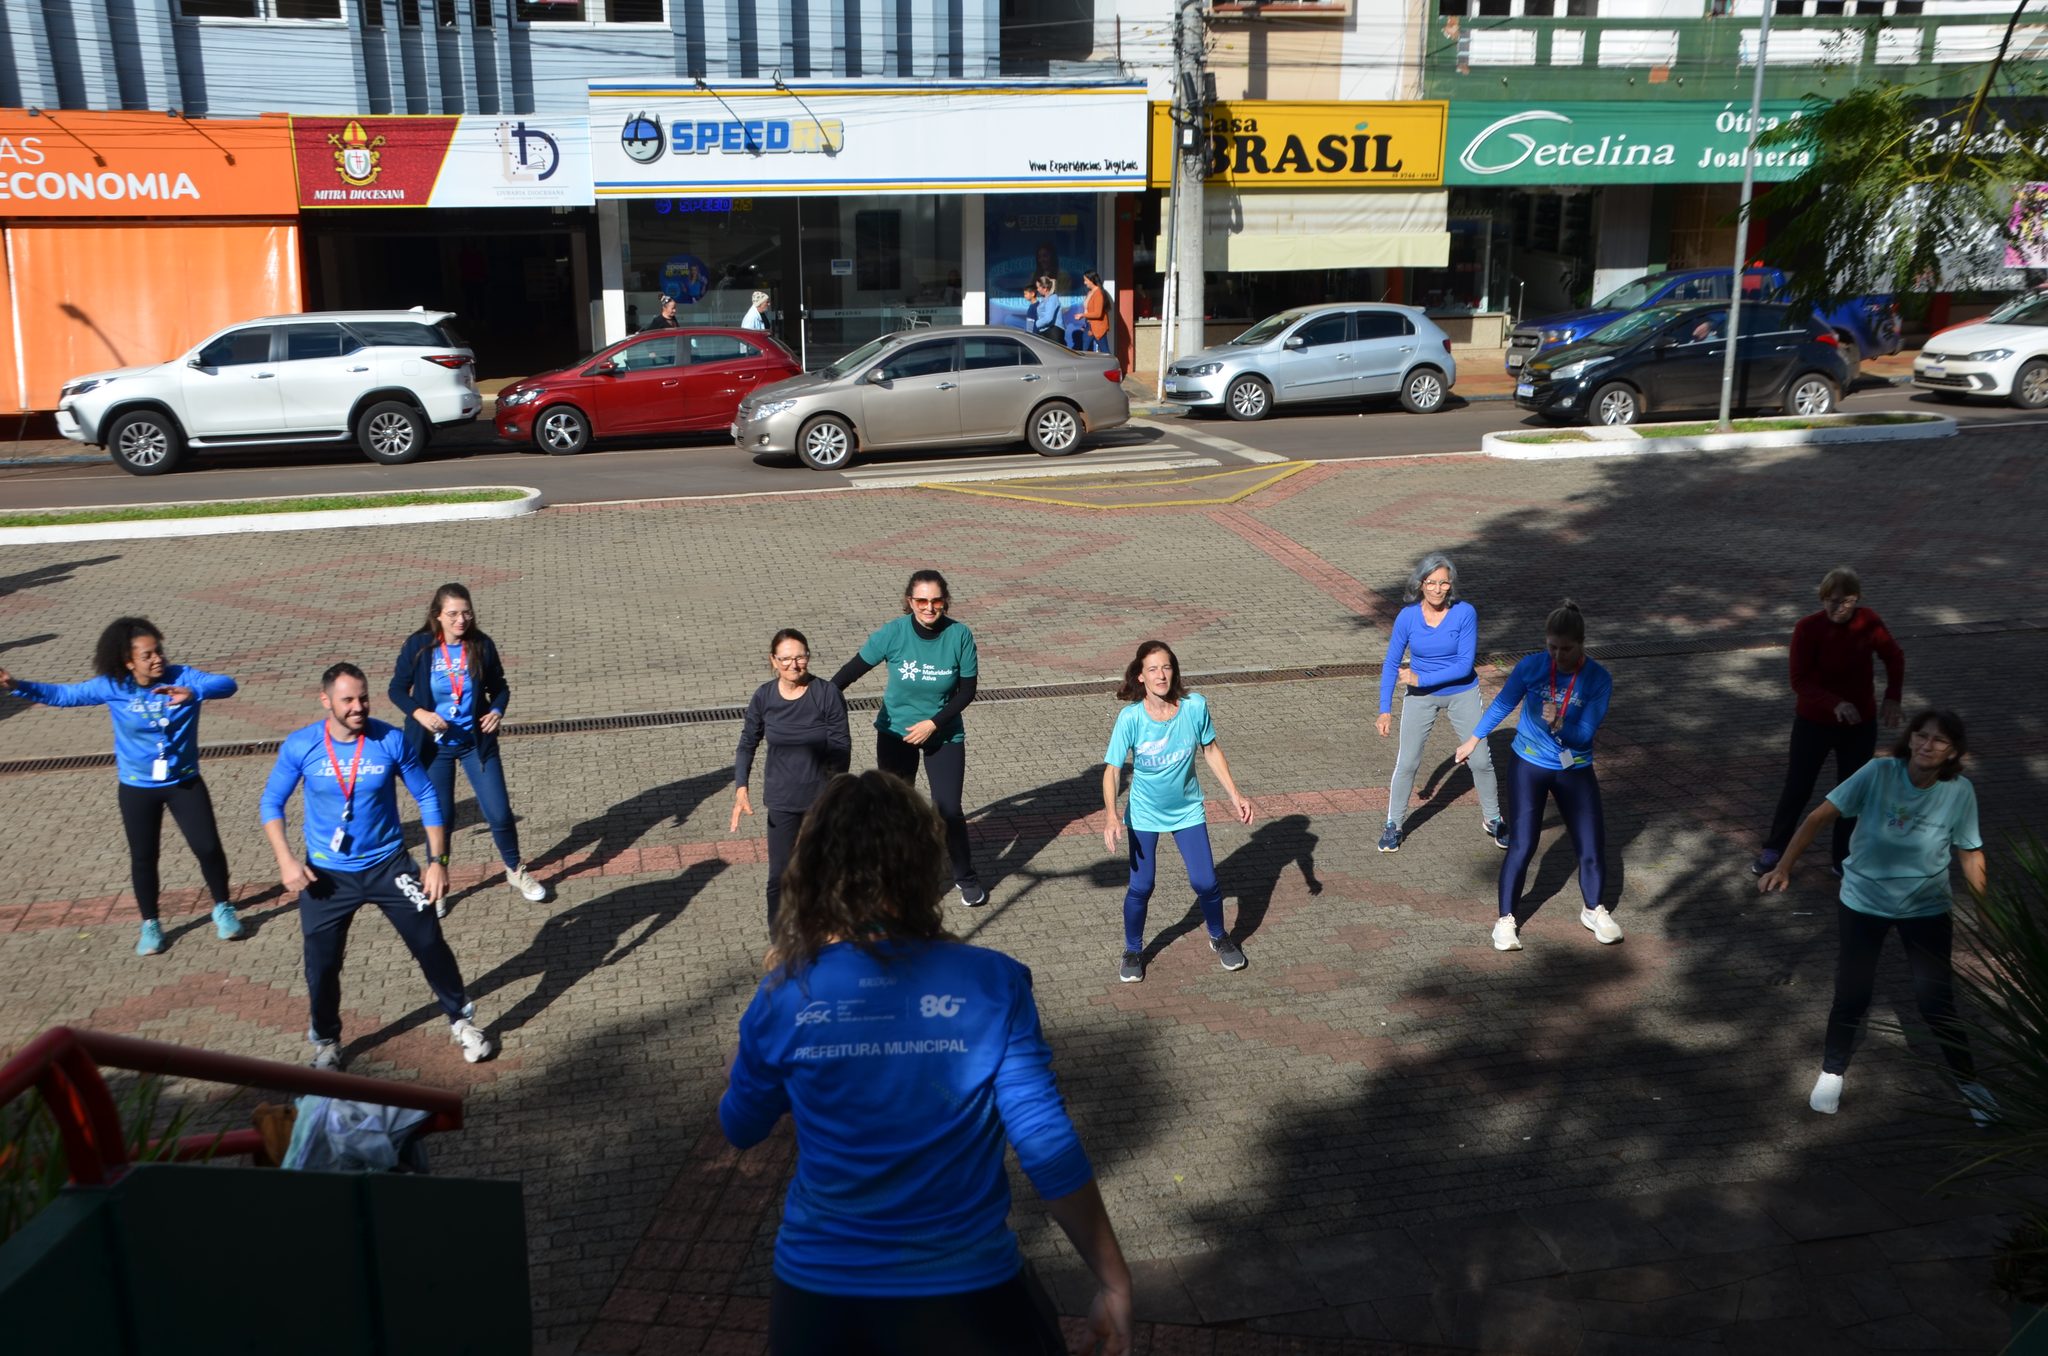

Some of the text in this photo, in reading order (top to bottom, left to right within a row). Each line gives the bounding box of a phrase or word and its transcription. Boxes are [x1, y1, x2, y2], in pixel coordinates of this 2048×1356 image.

[1715, 102, 1780, 133] Ótica
[671, 119, 844, 154] SPEEDRS
[314, 189, 405, 199] MITRA DIOCESANA
[793, 1039, 969, 1060] PREFEITURA MUNICIPAL
